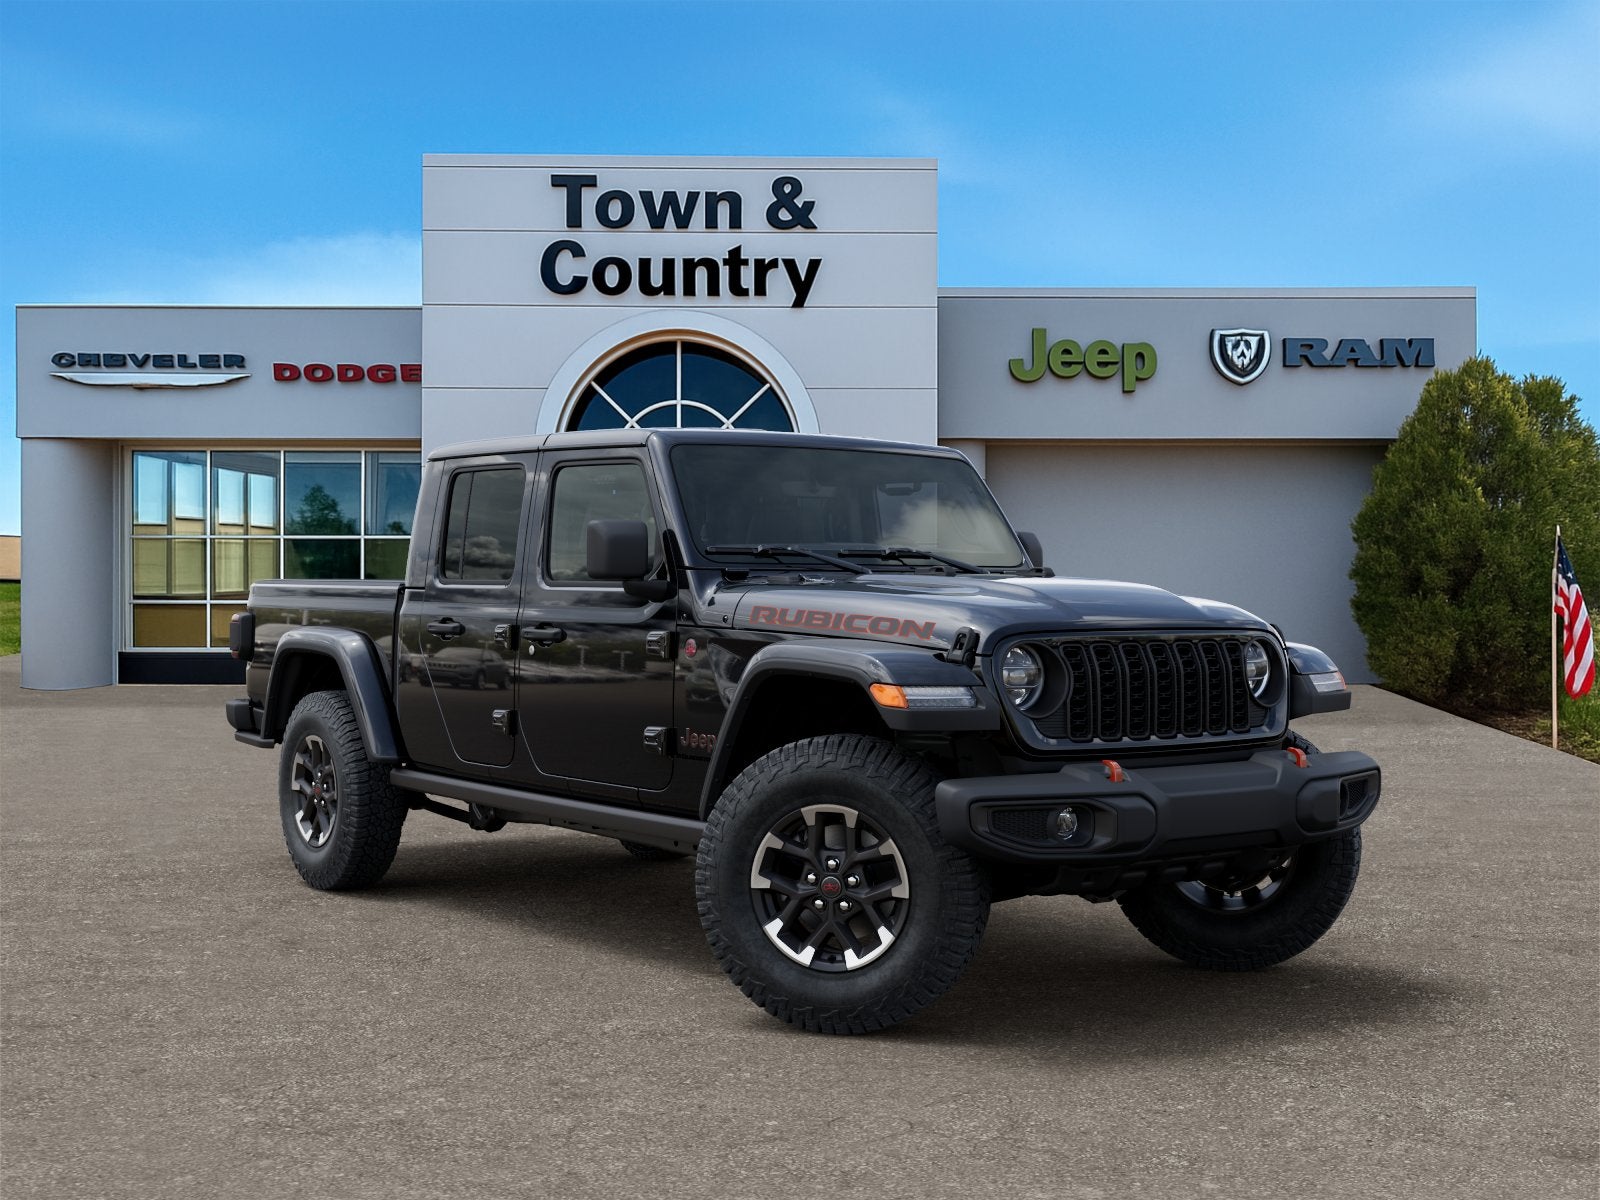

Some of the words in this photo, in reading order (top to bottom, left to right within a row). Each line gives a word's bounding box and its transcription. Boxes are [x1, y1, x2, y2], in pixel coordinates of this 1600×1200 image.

[550, 174, 743, 229] Town
[765, 175, 818, 230] &
[540, 239, 822, 308] Country
[1009, 327, 1158, 393] Jeep
[1282, 337, 1435, 368] RAM
[272, 362, 422, 383] DODGE
[750, 605, 936, 641] RUBICON
[680, 727, 717, 752] Jeep
